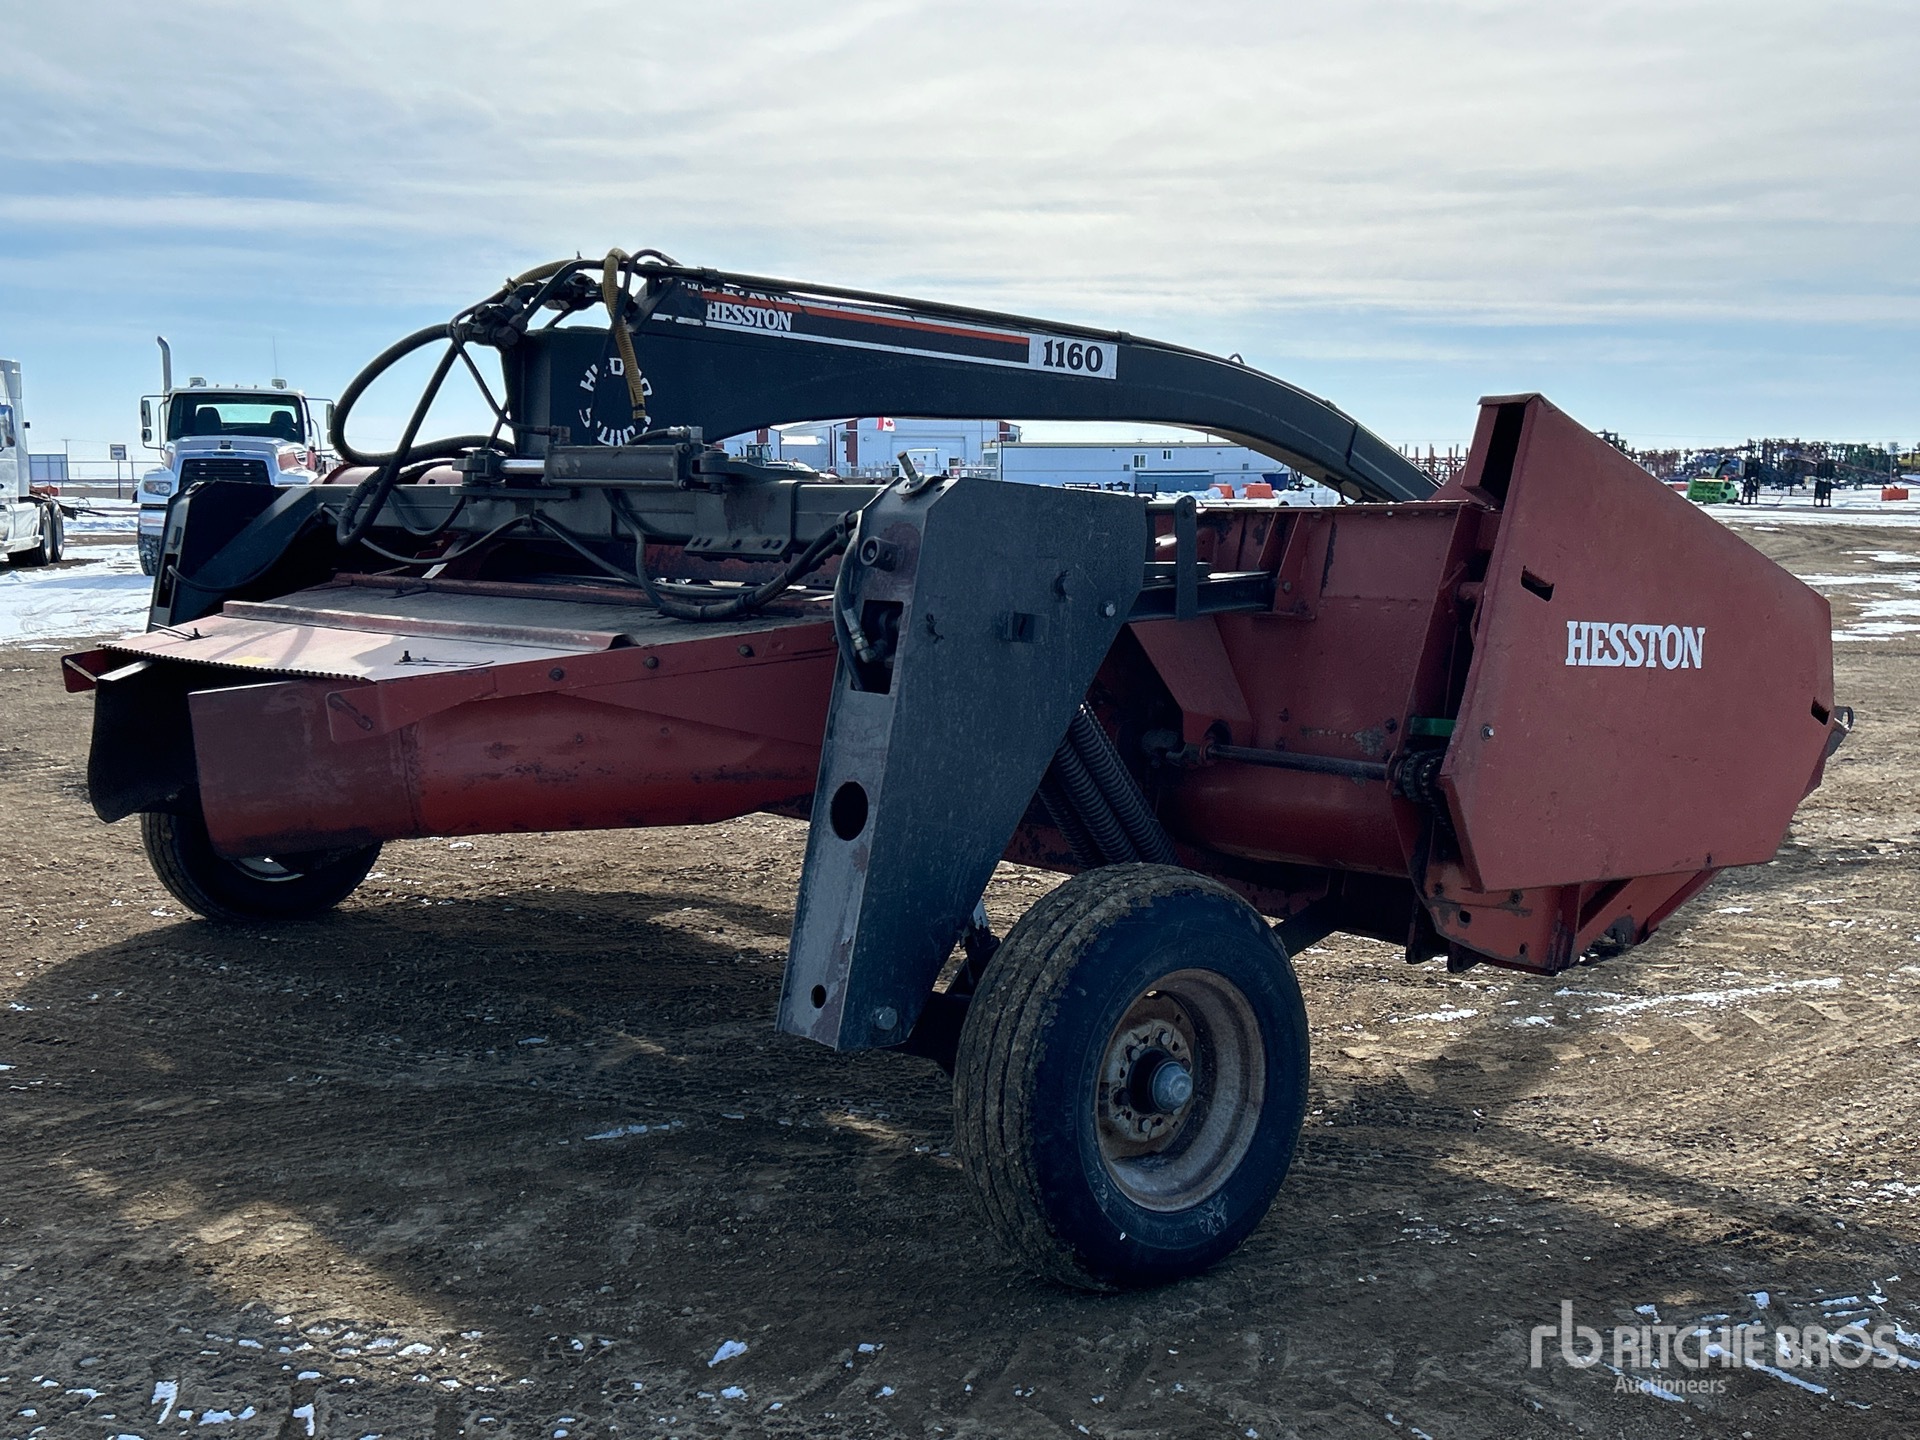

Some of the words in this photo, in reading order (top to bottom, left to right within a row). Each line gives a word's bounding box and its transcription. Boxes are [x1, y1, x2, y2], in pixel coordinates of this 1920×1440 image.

[706, 302, 793, 331] HESSTON
[1043, 339, 1103, 372] 1160
[1565, 621, 1705, 670] HESSTON
